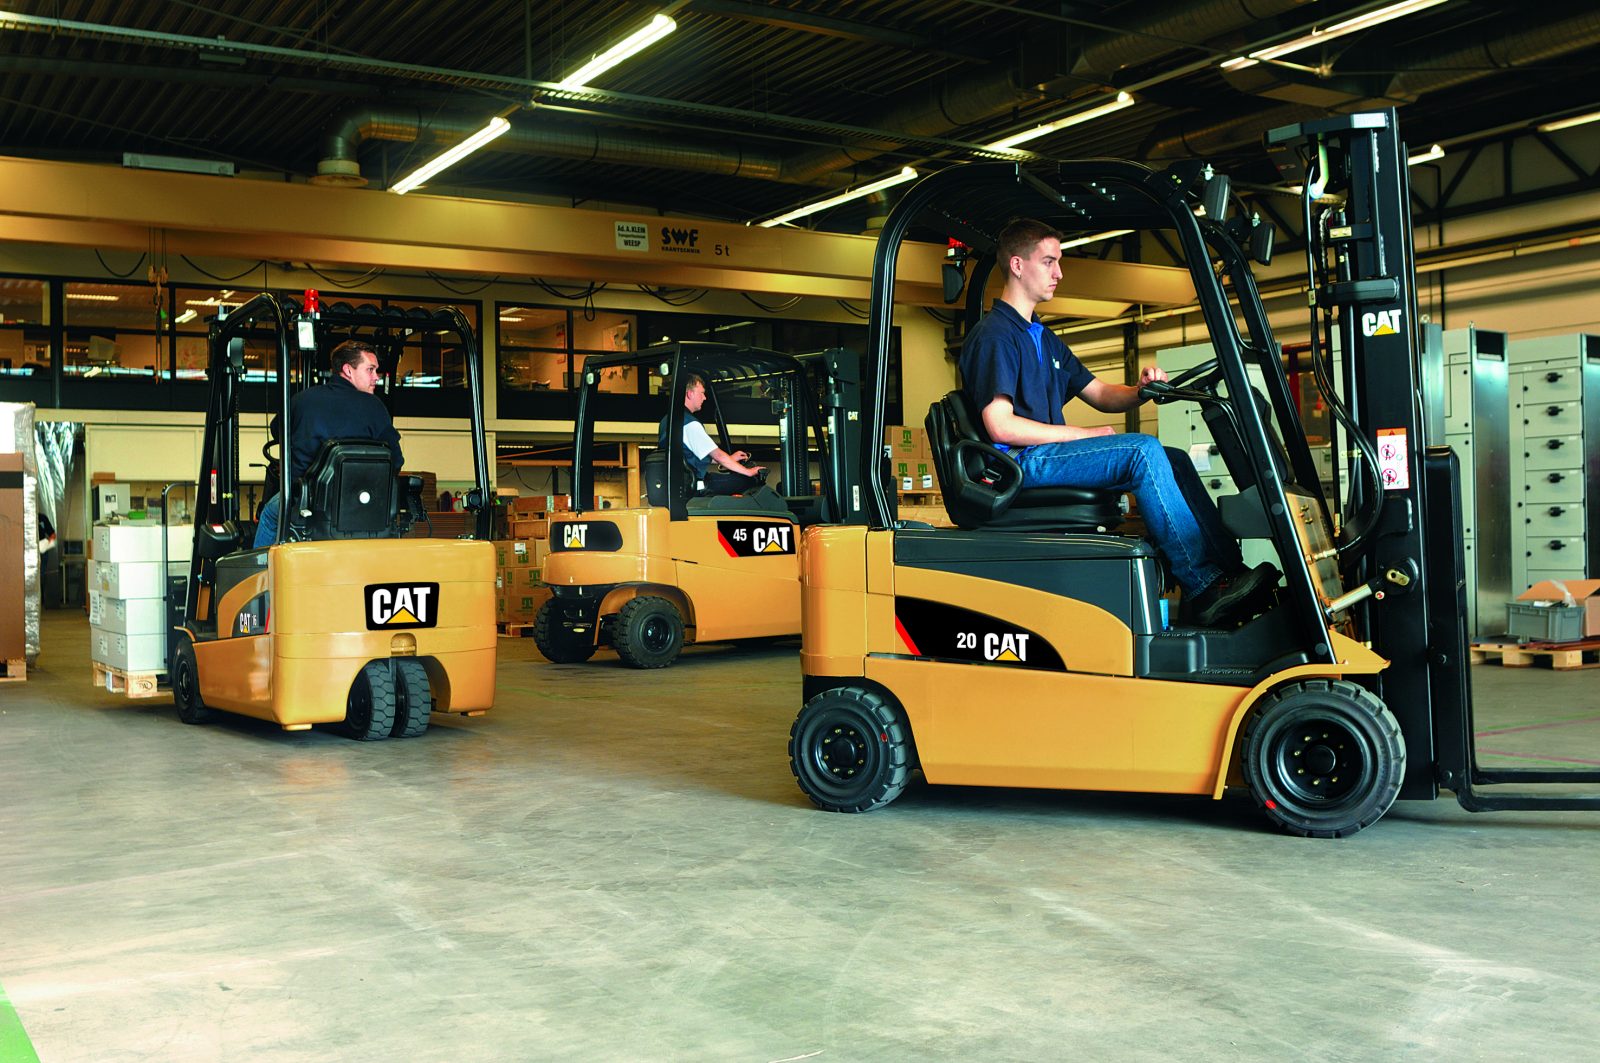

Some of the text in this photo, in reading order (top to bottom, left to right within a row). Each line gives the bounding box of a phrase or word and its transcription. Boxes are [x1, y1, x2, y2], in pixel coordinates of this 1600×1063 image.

[661, 227, 699, 247] SWF
[714, 245, 730, 256] 5 t
[1362, 309, 1402, 337] CAT
[848, 411, 858, 420] CAT
[563, 524, 588, 548] CAT
[733, 526, 790, 552] 45 CAT
[372, 587, 431, 624] CAT
[239, 612, 250, 633] CAT
[956, 632, 1030, 661] 20 CAT
